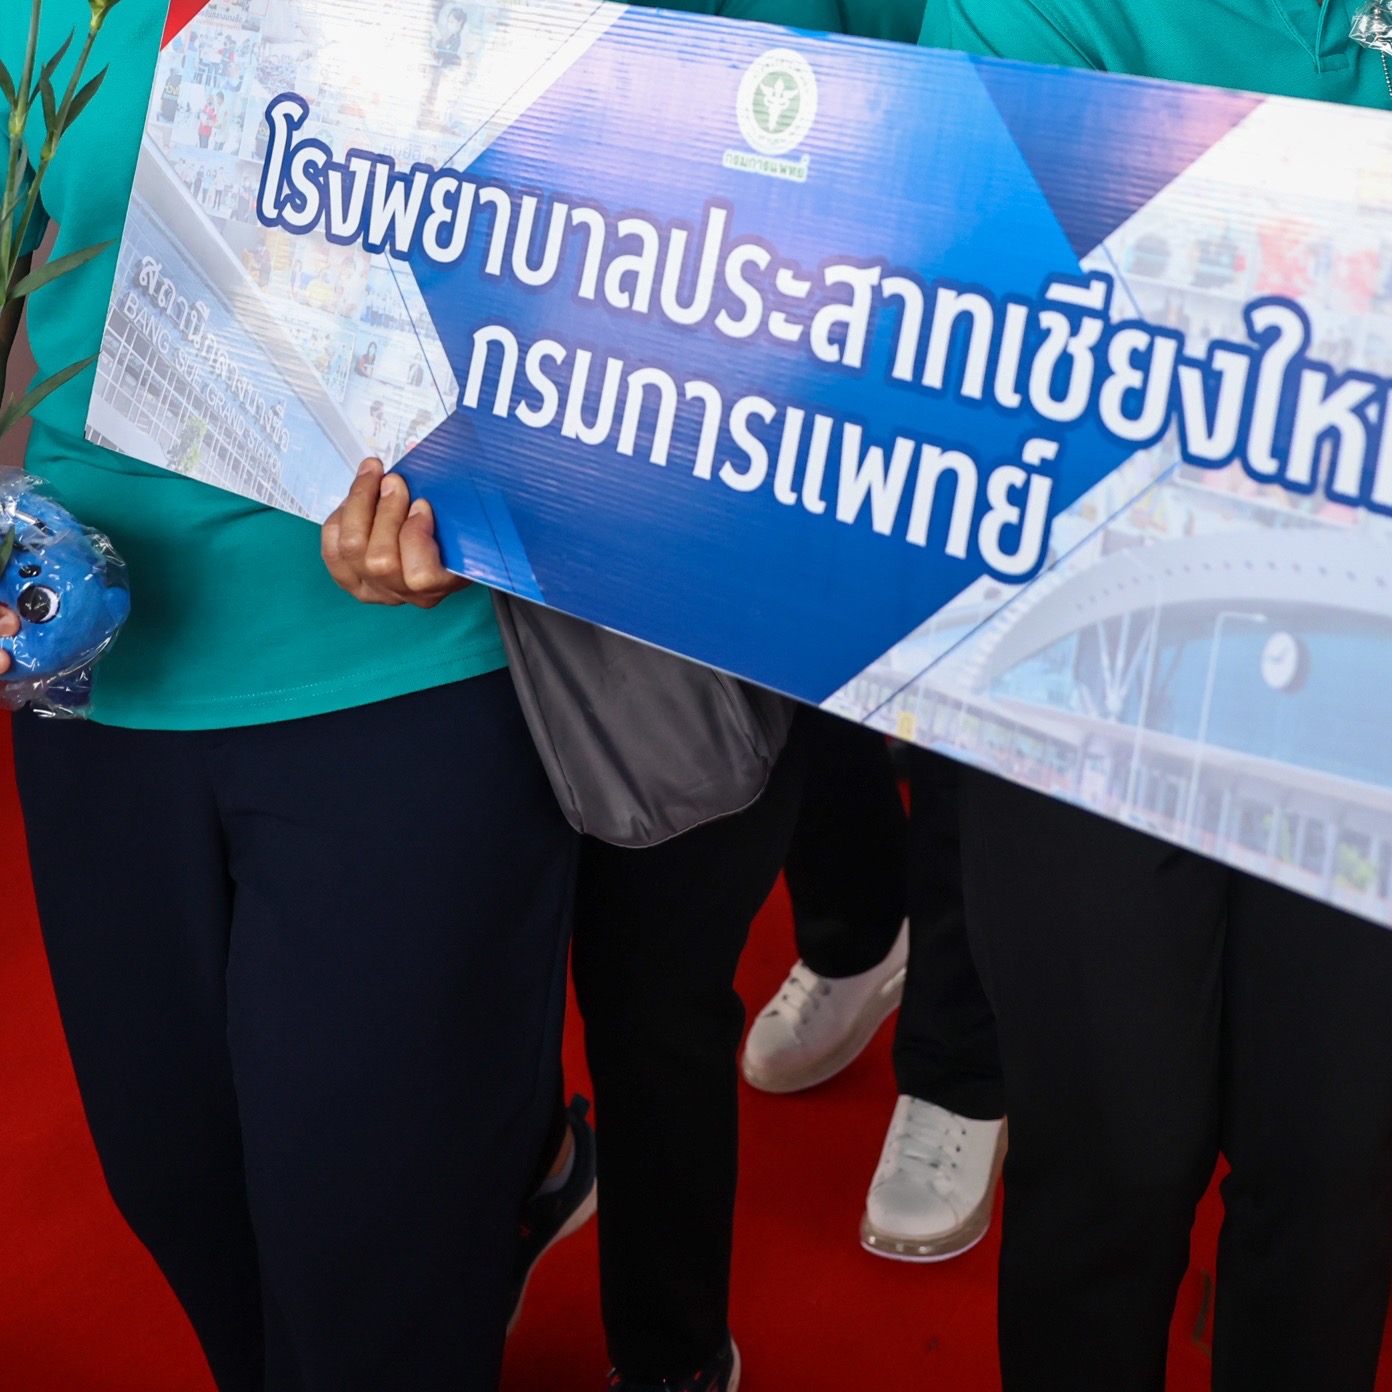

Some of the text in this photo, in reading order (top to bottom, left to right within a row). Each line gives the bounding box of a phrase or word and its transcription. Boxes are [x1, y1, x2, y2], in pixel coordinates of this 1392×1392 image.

[724, 151, 808, 181] กรมการแพทย์
[122, 291, 284, 480] BANG SUE GRAND STATION
[138, 254, 290, 454] สถานีกลางบางซื่อ
[464, 322, 1061, 578] กรมการแพทย์
